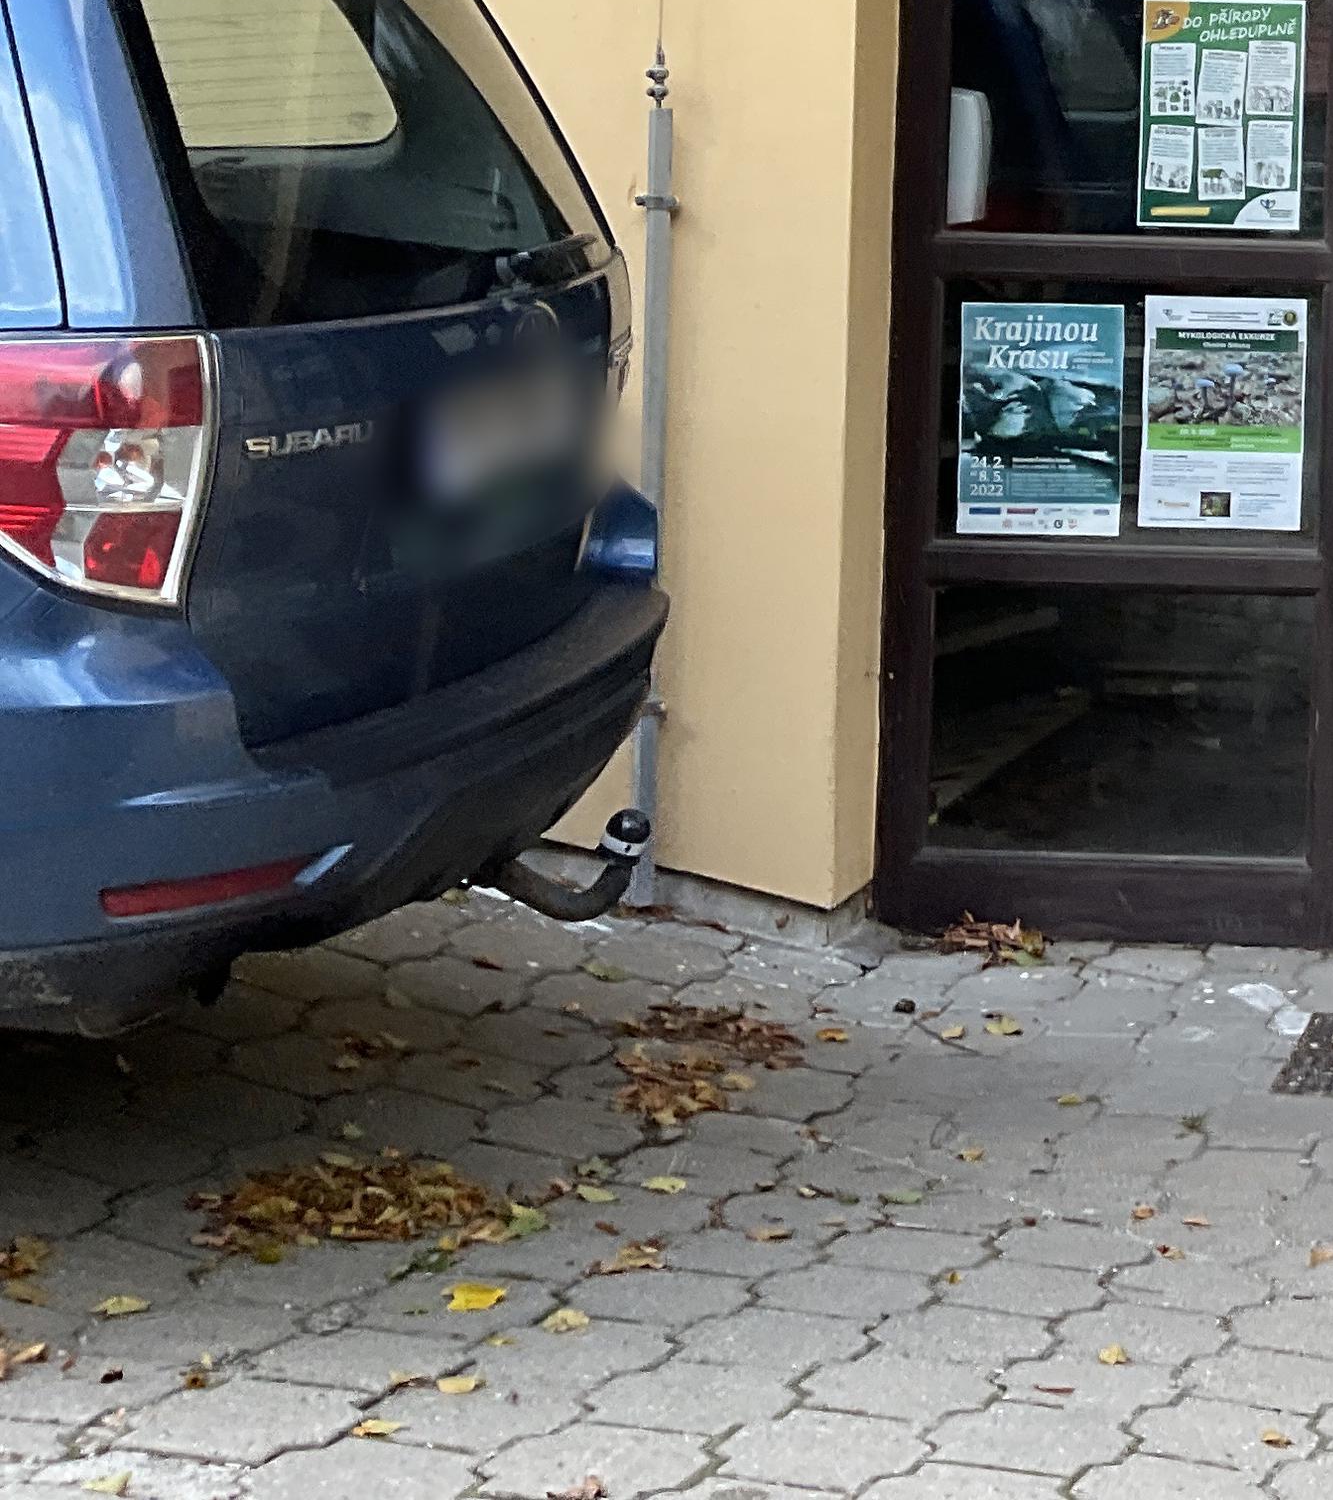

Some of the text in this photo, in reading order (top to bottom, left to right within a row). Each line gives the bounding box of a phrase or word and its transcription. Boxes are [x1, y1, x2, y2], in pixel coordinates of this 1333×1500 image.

[1182, 7, 1272, 30] DO PŘÍRODY
[1199, 17, 1297, 43] OHLEDUPLNĚ
[973, 314, 1099, 347] Krajinou
[986, 344, 1070, 370] Krasu
[245, 420, 375, 460] SUBARU
[970, 483, 1004, 497] 2022
